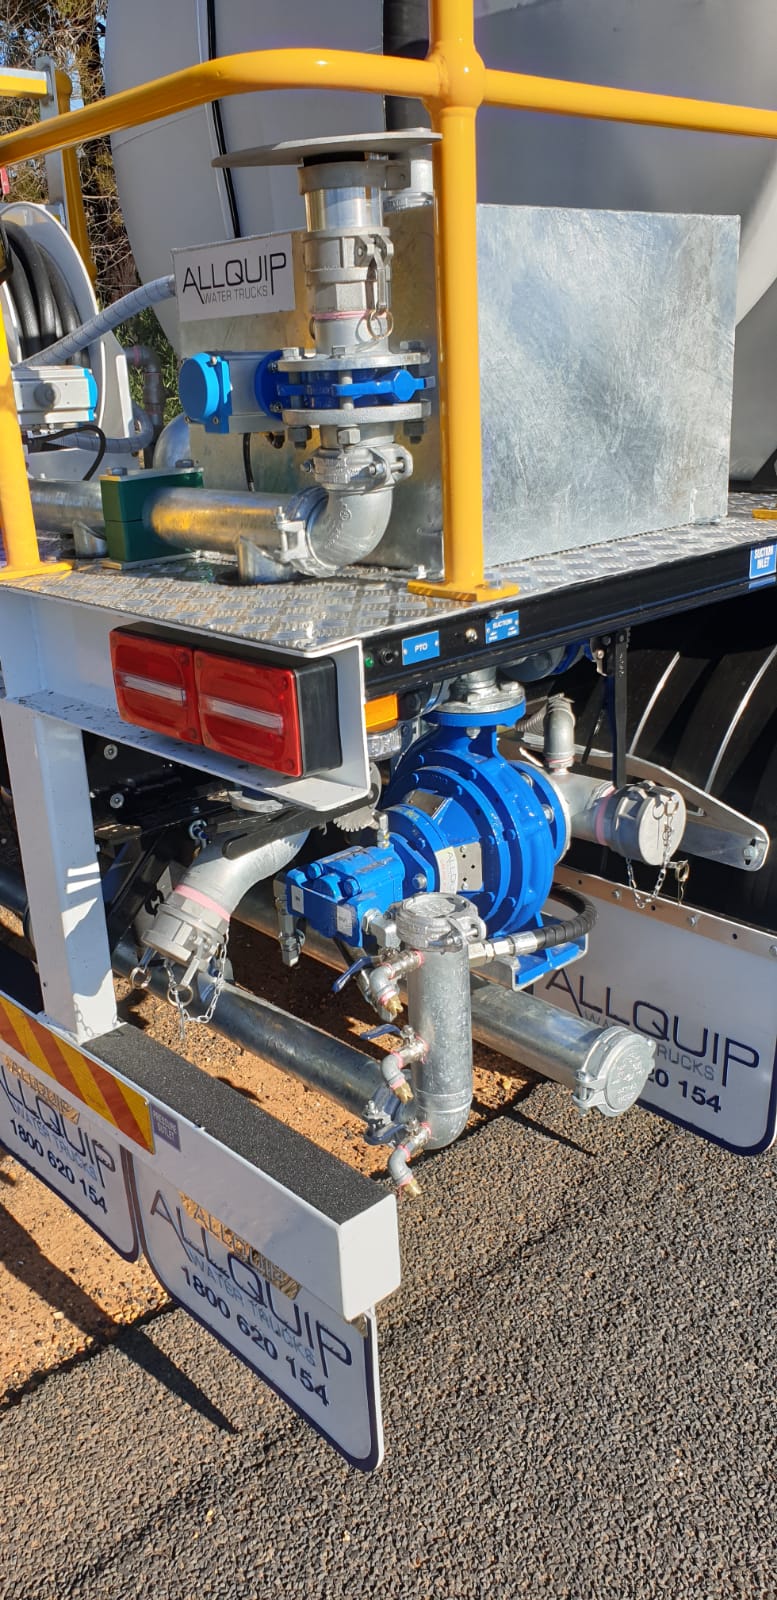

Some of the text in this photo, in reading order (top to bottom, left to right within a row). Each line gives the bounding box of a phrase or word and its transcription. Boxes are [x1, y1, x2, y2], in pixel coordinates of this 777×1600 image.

[182, 252, 287, 305] ALLQUIP
[203, 285, 268, 305] WATER TRUCKS
[414, 642, 429, 653] PTO
[545, 967, 760, 1088] ALLQUIP
[656, 1042, 716, 1082] RUCKS
[678, 1080, 722, 1113] 154
[10, 1119, 108, 1215] 1800 620 154
[151, 1189, 352, 1379] ALLQUIP
[187, 1247, 245, 1307] WATER
[181, 1265, 330, 1407] 1800 620 154
